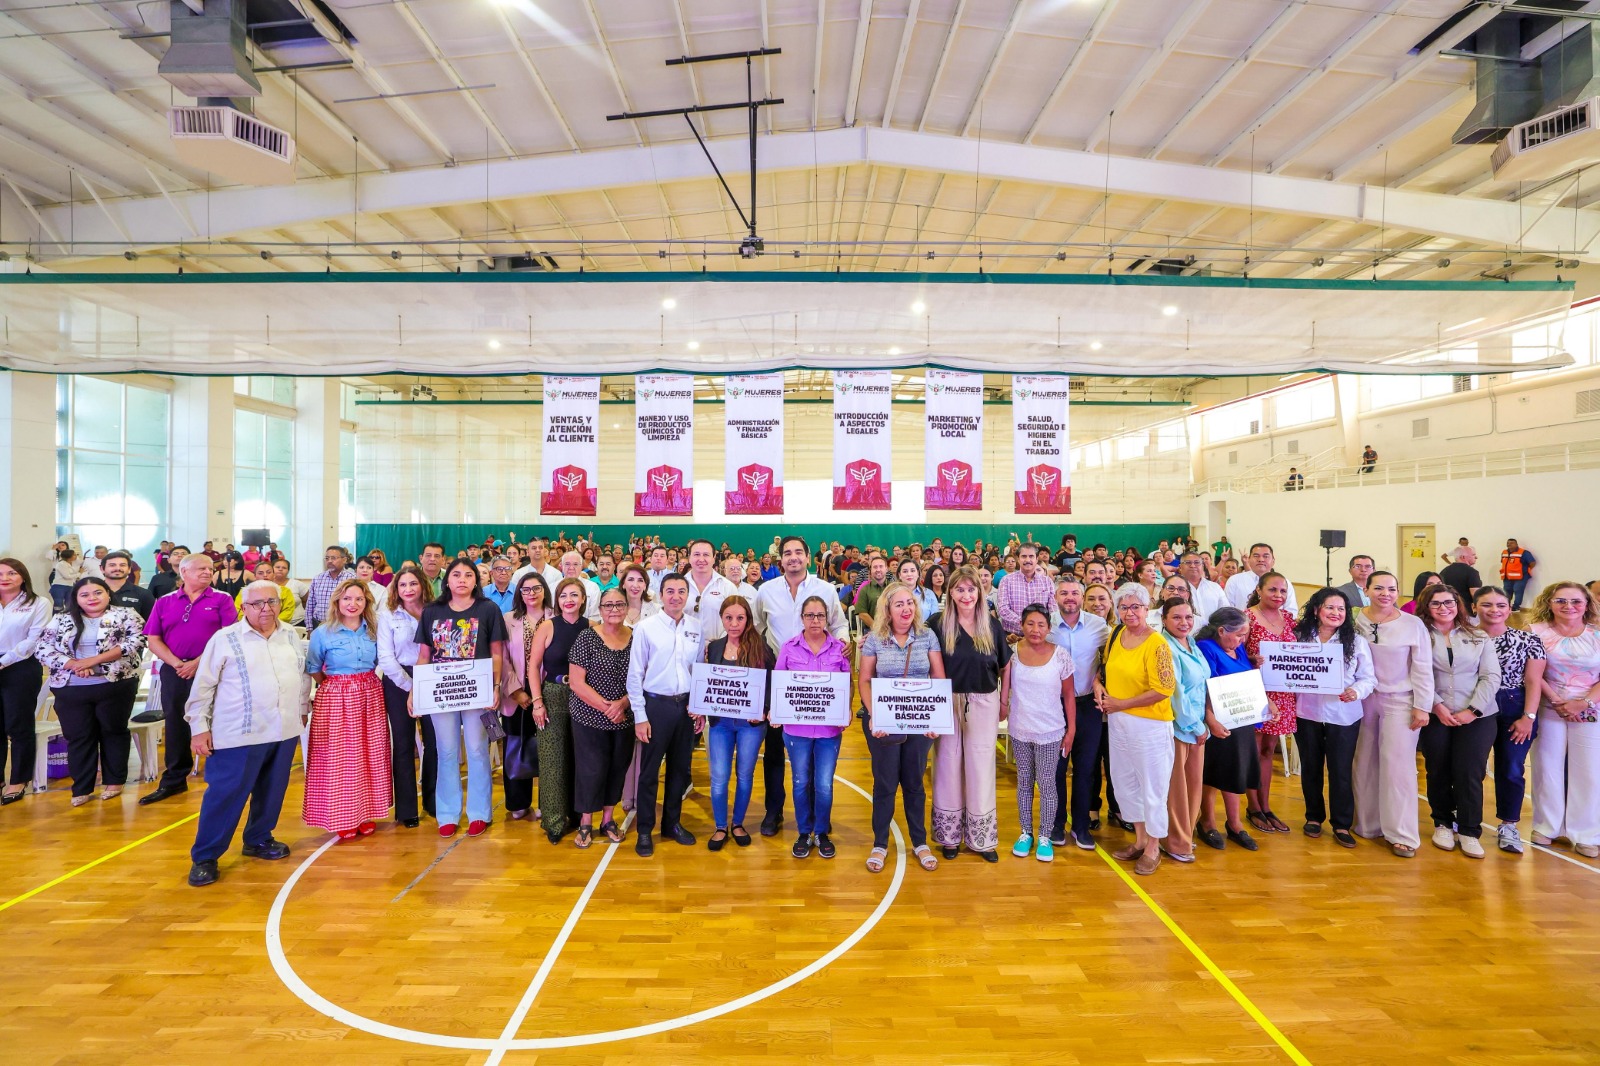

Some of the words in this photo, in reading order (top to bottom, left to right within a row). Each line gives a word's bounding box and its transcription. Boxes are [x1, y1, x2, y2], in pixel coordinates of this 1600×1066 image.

[550, 416, 583, 424] VENTAS
[586, 415, 592, 424] Y
[834, 412, 889, 420] INTRODUCCIÓN
[928, 415, 974, 423] MARKETING
[1027, 415, 1054, 423] SALUD,
[727, 418, 780, 426] ADMINISTRACIÓN
[846, 420, 886, 428] ASPECTOS
[549, 423, 592, 433] ATENCIÓN
[931, 423, 978, 431] PROMOCIÓN
[1017, 423, 1060, 431] SEGURIDAD
[546, 434, 557, 443] AL
[558, 434, 595, 443] CLIENTE
[740, 431, 768, 439] BÁSICAS
[1269, 654, 1325, 664] MARKETING
[1272, 663, 1329, 673] PROMOCIÓN
[1286, 673, 1317, 681] LOCAL
[435, 679, 476, 689] SEGURIDAD
[707, 678, 741, 688] VENTAS
[439, 687, 467, 695] HIGIENE
[706, 687, 748, 698] ATENCIÓN
[445, 693, 478, 701] TRABAJO
[877, 695, 947, 703] ADMINISTRACIÓN
[716, 697, 751, 707] CLIENTE
[789, 698, 820, 706] QUÍMICOS
[1229, 704, 1255, 716] LEGALES
[894, 712, 931, 720] BÁSICAS
